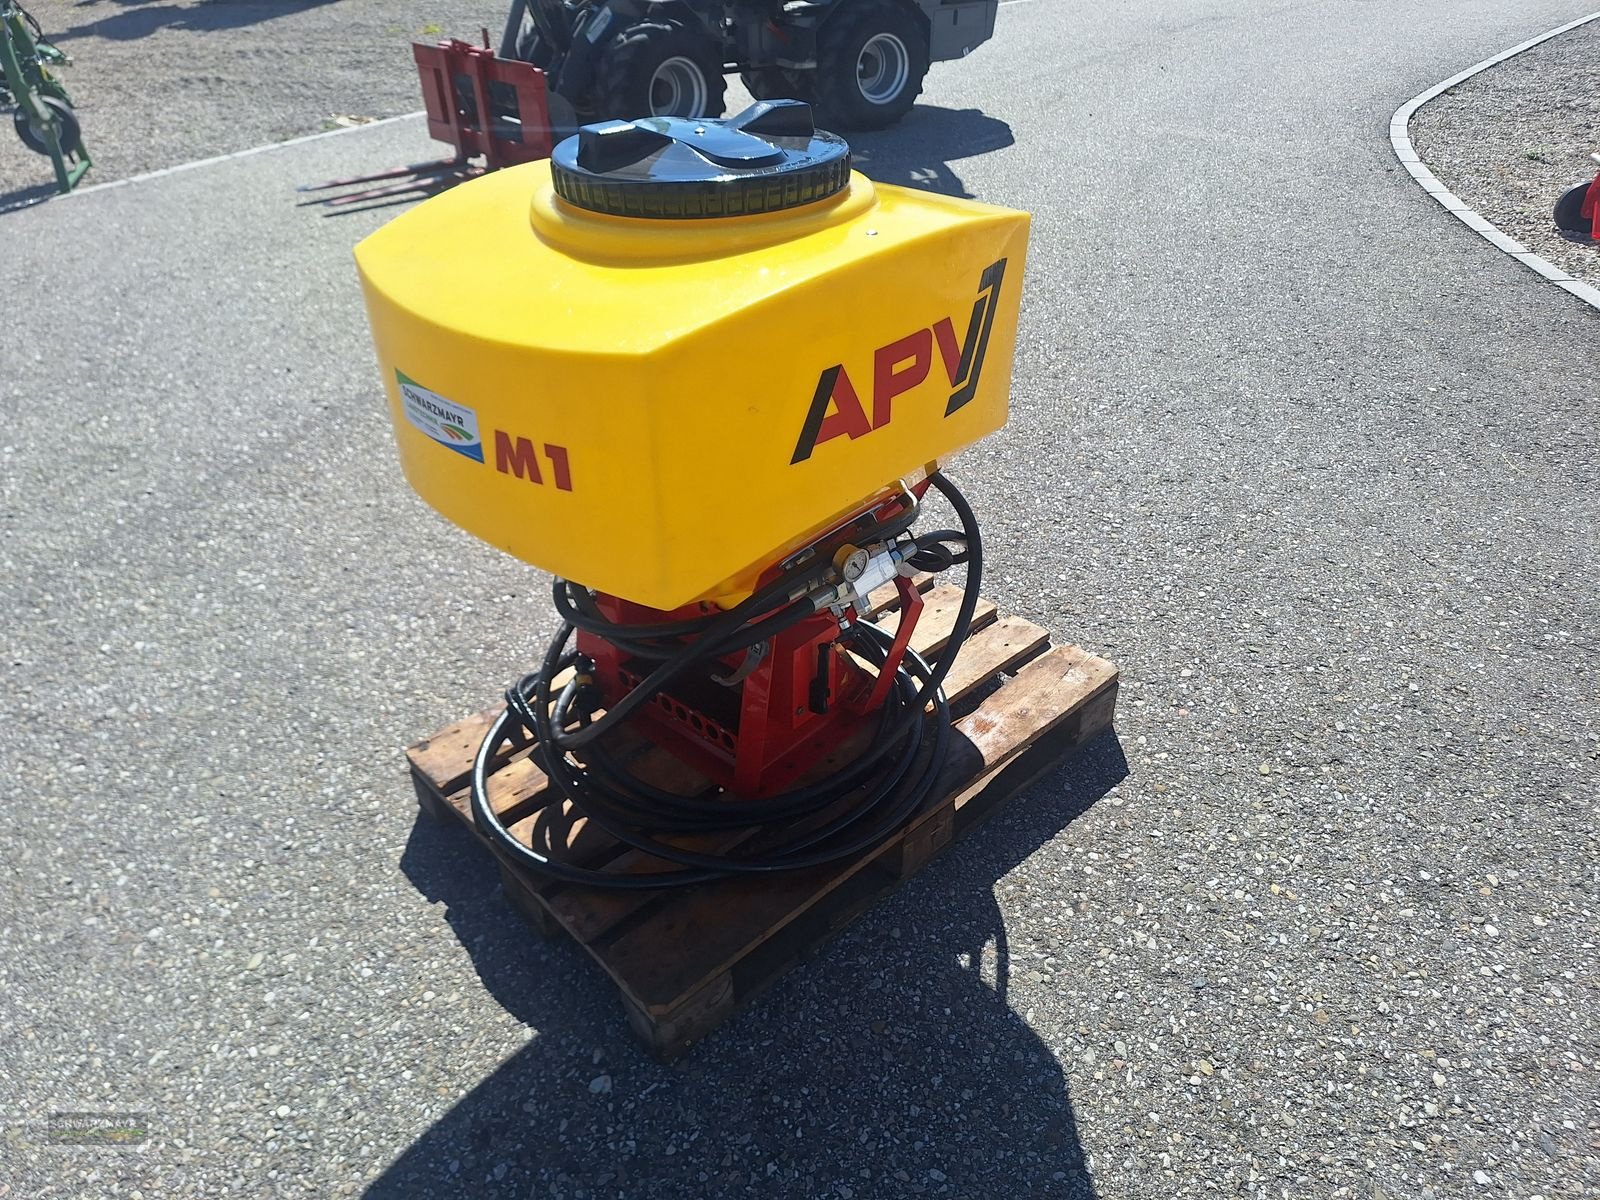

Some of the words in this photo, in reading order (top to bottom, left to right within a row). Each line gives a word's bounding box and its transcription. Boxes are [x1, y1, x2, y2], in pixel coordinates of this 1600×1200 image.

[790, 260, 1006, 465] APV
[402, 385, 464, 427] SCHWARZMAYR
[495, 429, 573, 492] M1
